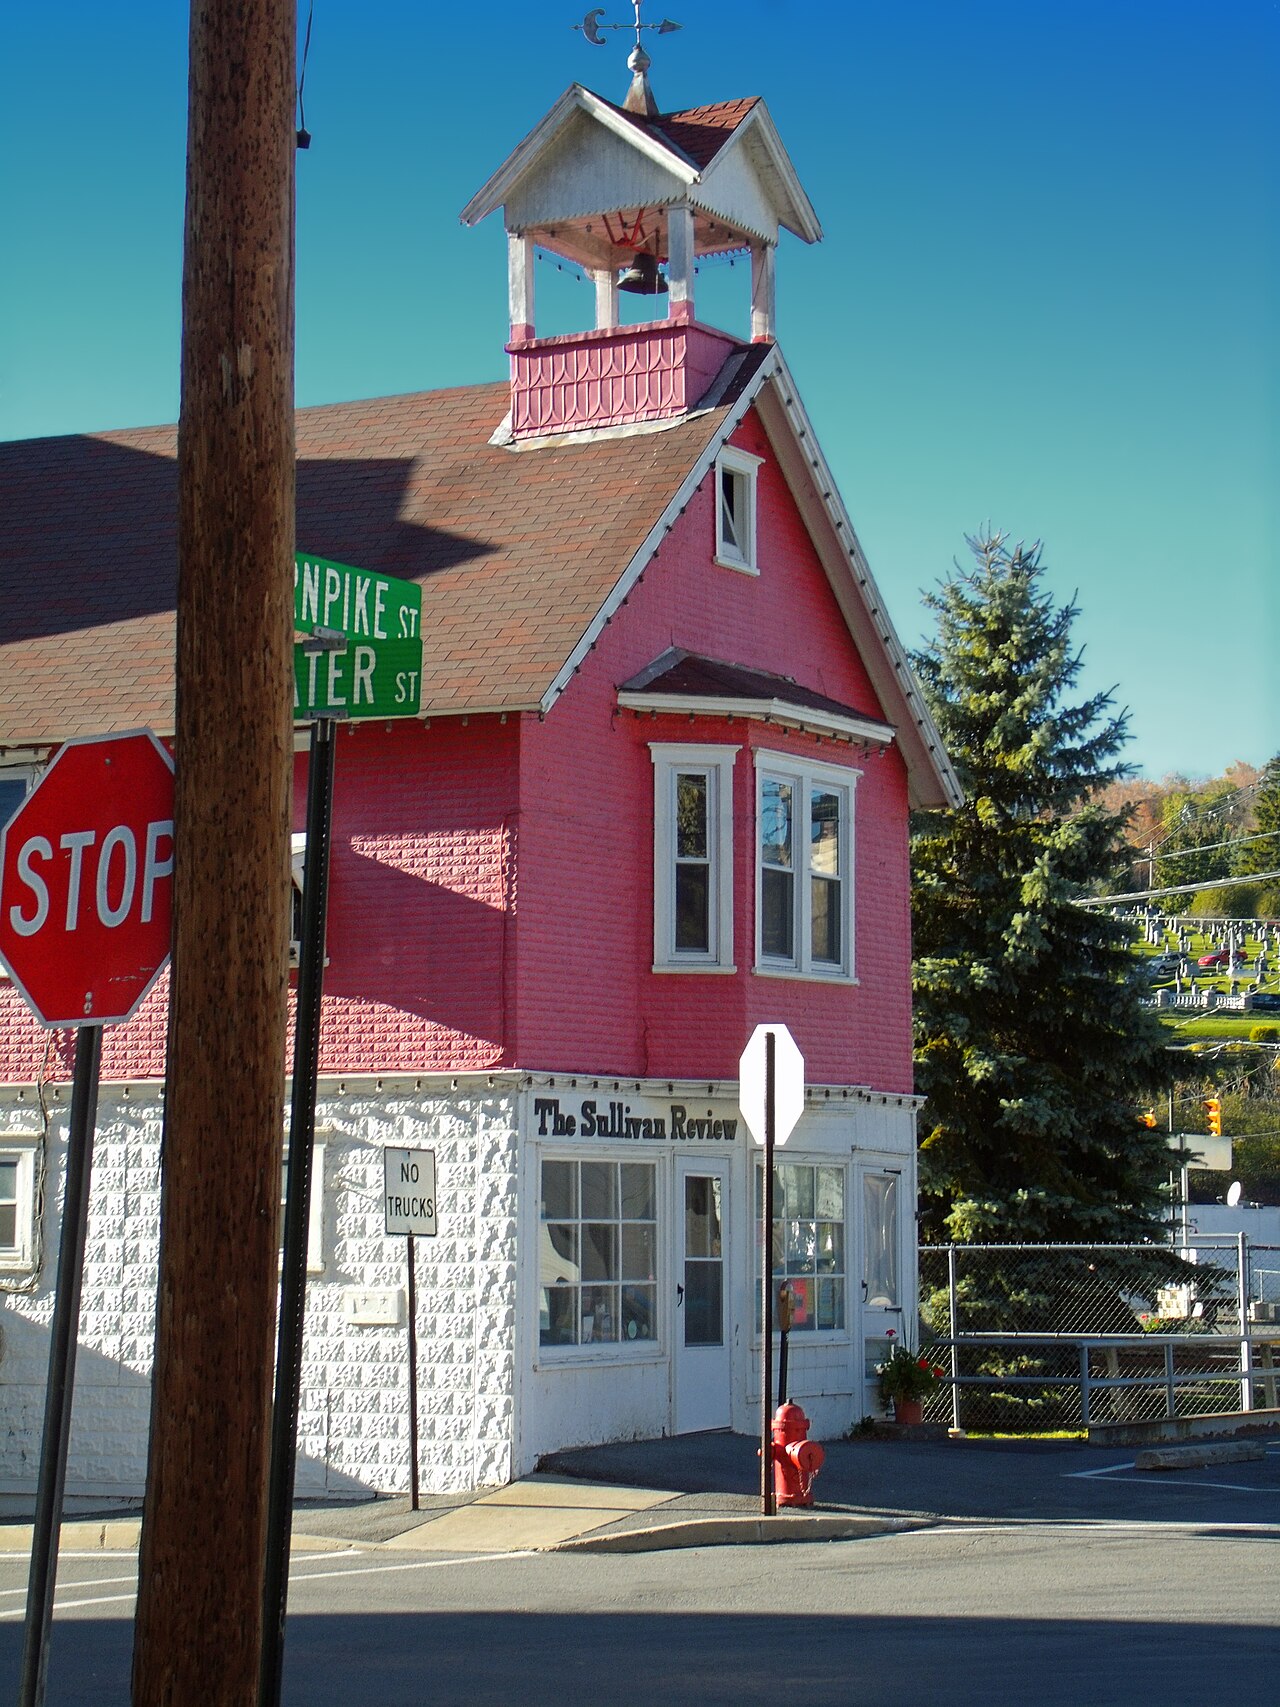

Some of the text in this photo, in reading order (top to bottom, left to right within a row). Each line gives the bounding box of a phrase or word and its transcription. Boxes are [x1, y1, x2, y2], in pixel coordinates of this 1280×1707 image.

[397, 605, 419, 639] ST
[394, 671, 419, 703] ST
[9, 819, 174, 937] STOP
[534, 1098, 738, 1141] The Sullivan Review
[400, 1162, 420, 1183] NO
[387, 1196, 434, 1218] TRUCKS
